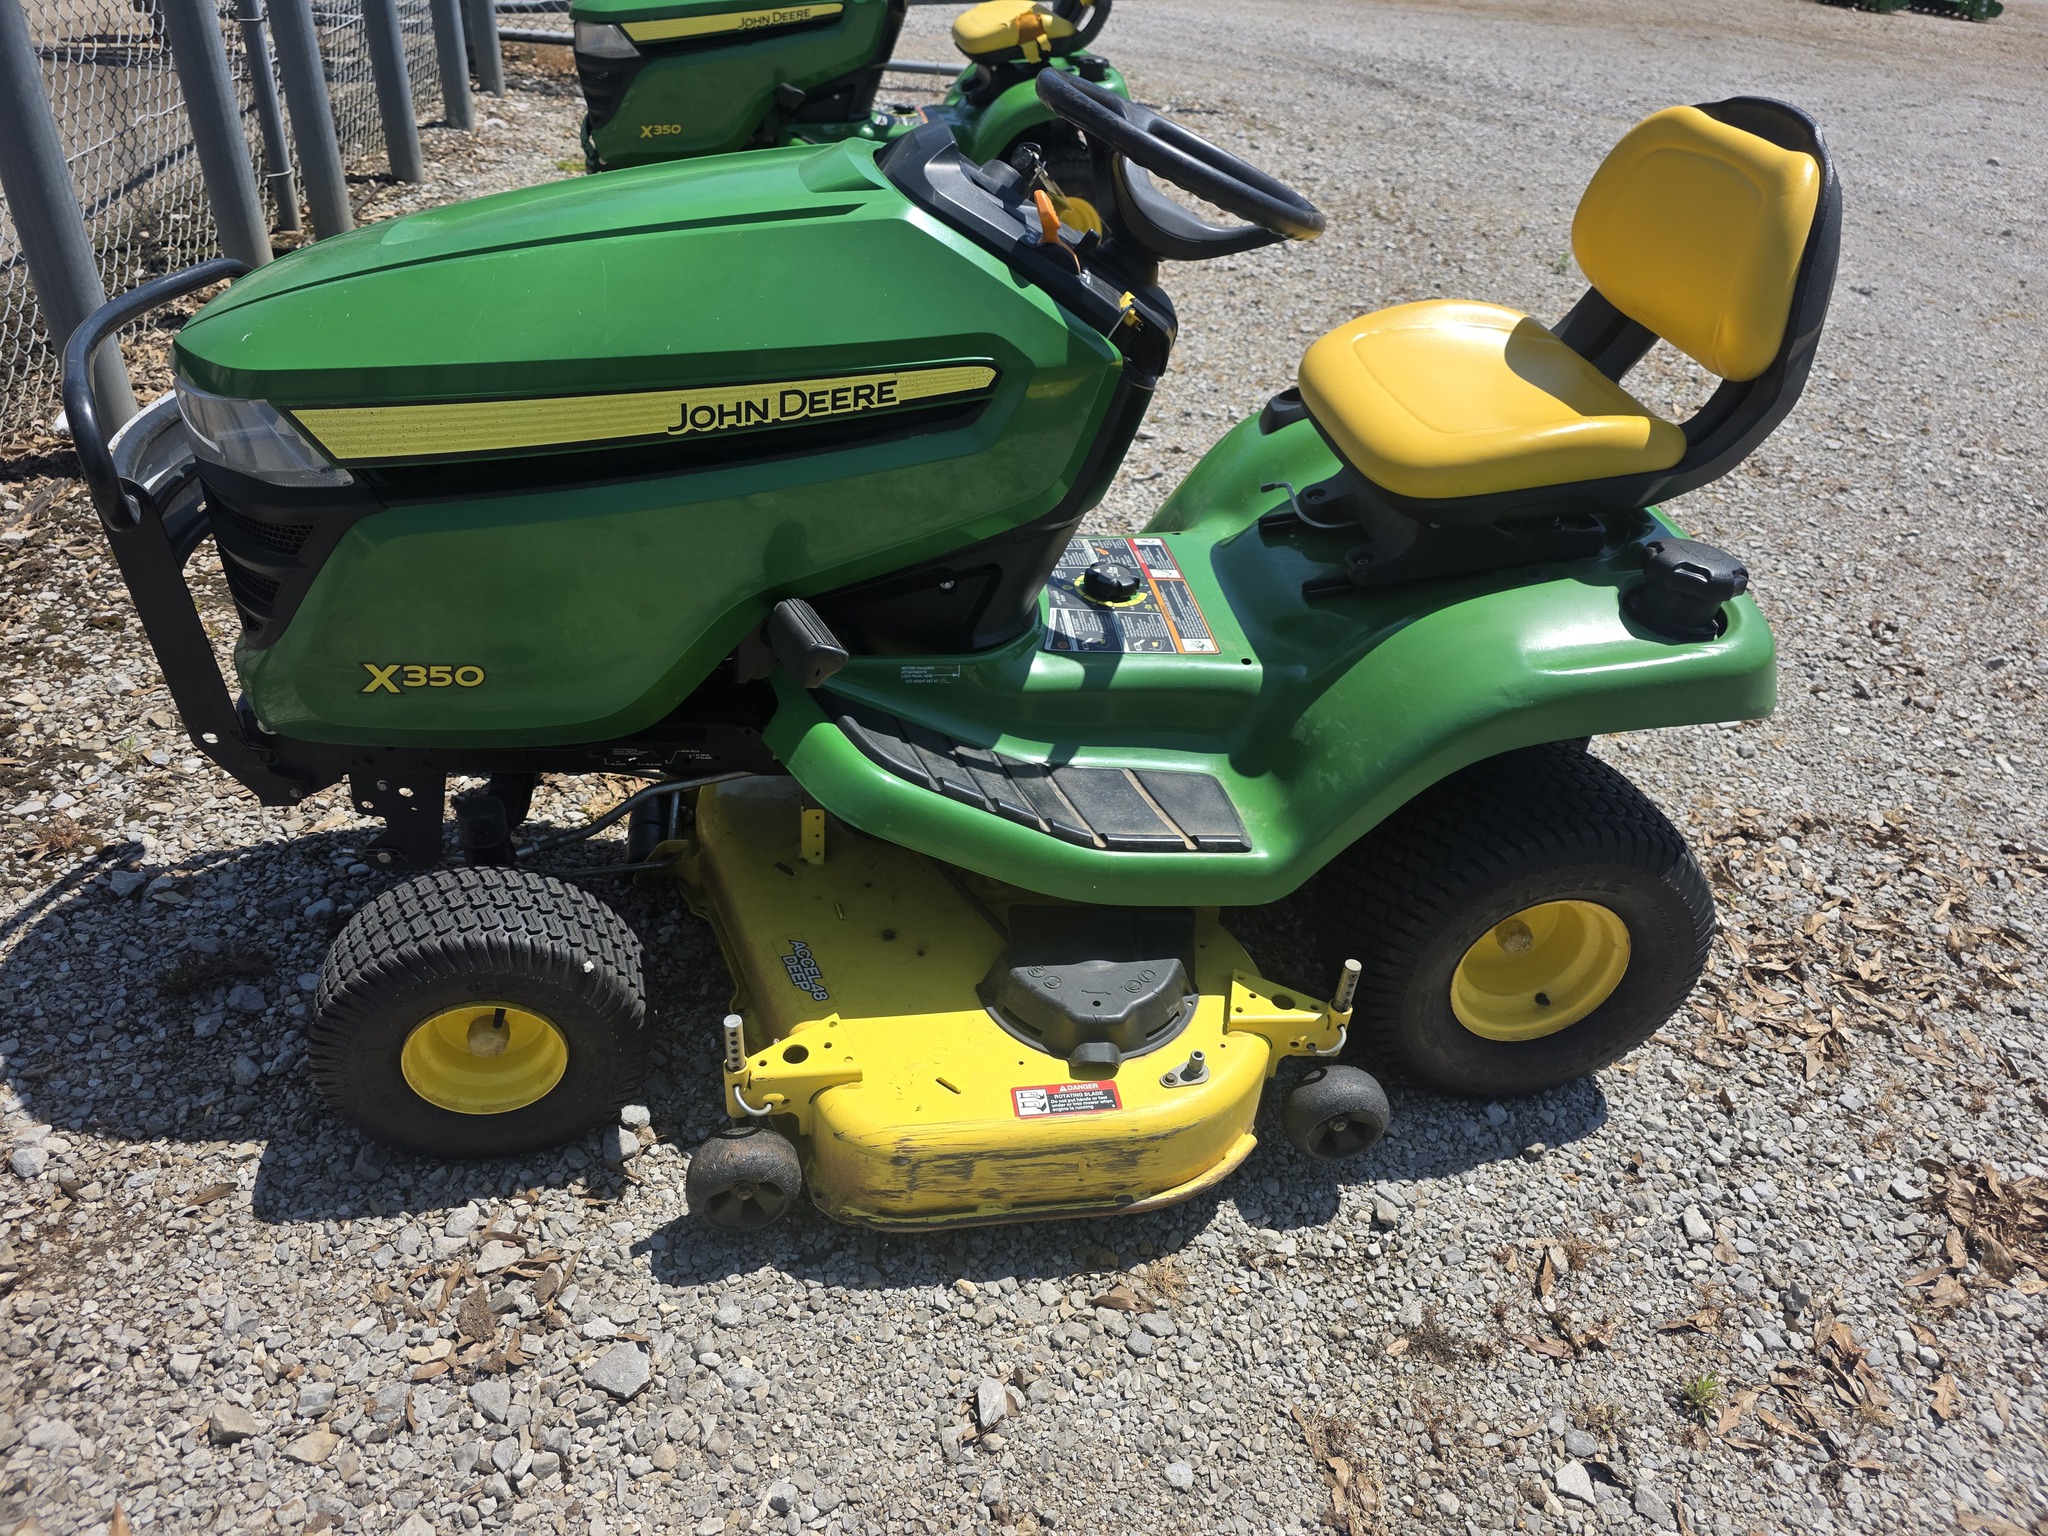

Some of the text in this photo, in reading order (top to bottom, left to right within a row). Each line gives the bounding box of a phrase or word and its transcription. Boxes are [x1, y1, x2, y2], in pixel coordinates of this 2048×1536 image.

[737, 8, 812, 28] JOHN DEERE
[640, 124, 681, 139] X350
[667, 379, 899, 433] JOHN DEERE
[361, 662, 485, 693] X350
[781, 955, 811, 992] DEEP
[1067, 1083, 1099, 1091] DANGER
